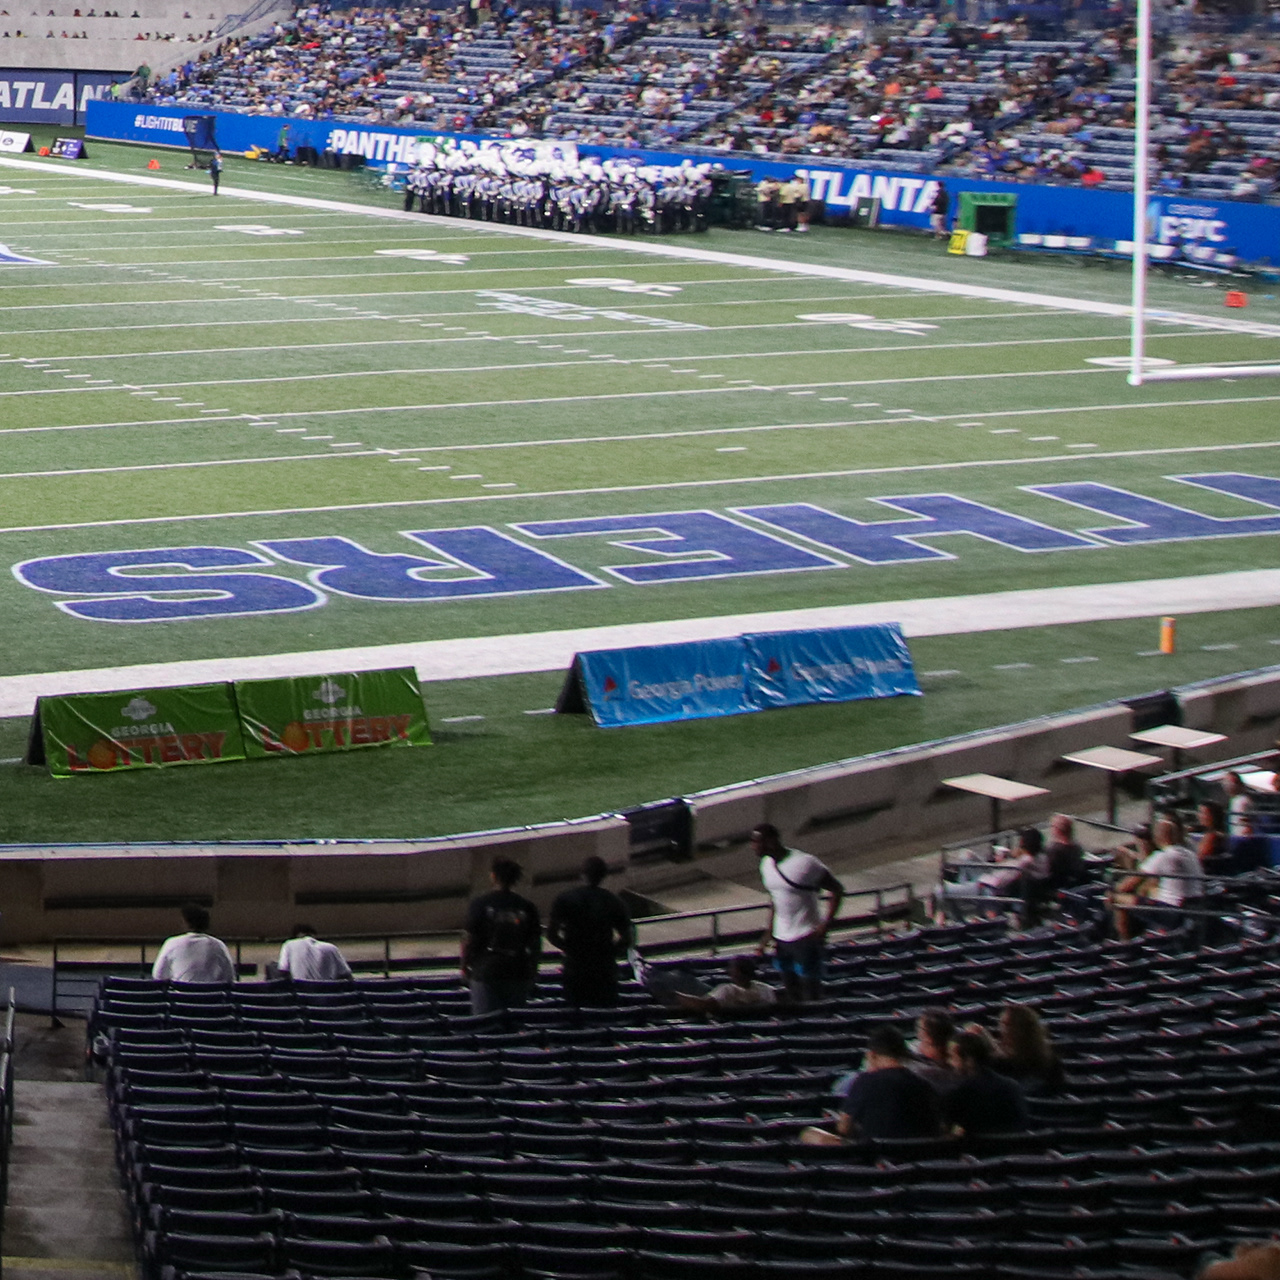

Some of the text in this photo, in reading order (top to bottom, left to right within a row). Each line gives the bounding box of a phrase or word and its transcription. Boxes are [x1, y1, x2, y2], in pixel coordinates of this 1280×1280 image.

[332, 129, 418, 164] PANTHE
[629, 673, 744, 701] Georgia Power
[302, 705, 362, 721] GEORGIA
[111, 722, 175, 739] GEORGIA
[67, 731, 228, 772] LOTTERY
